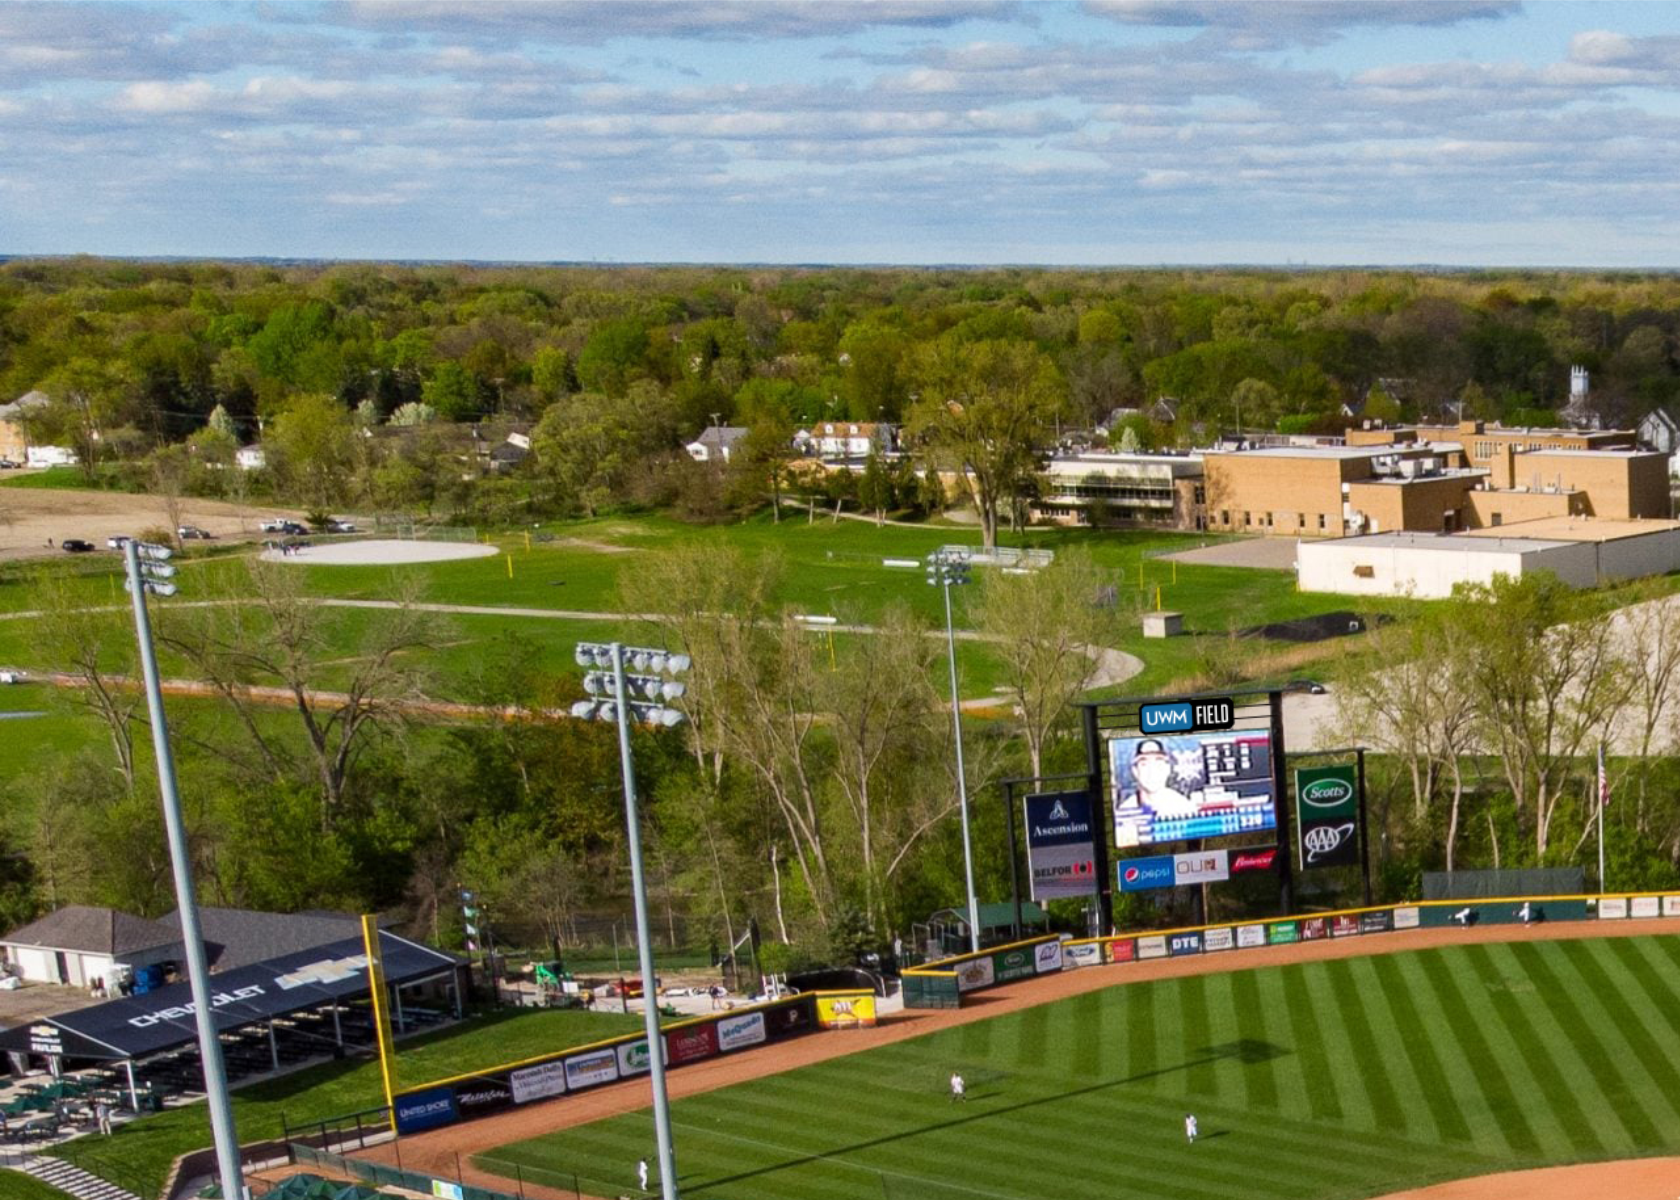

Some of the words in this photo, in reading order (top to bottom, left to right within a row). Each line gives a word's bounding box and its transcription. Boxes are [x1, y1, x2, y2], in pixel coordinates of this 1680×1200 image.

[1146, 709, 1187, 726] UWM
[1196, 703, 1229, 725] FIELD
[1311, 787, 1345, 799] Scotts
[1034, 822, 1088, 837] Ascension
[1308, 828, 1337, 851] AAA
[1034, 865, 1072, 878] BELFOR
[1141, 867, 1170, 881] pepsi
[1172, 936, 1199, 950] DTE
[127, 984, 266, 1028] CHEVOLET
